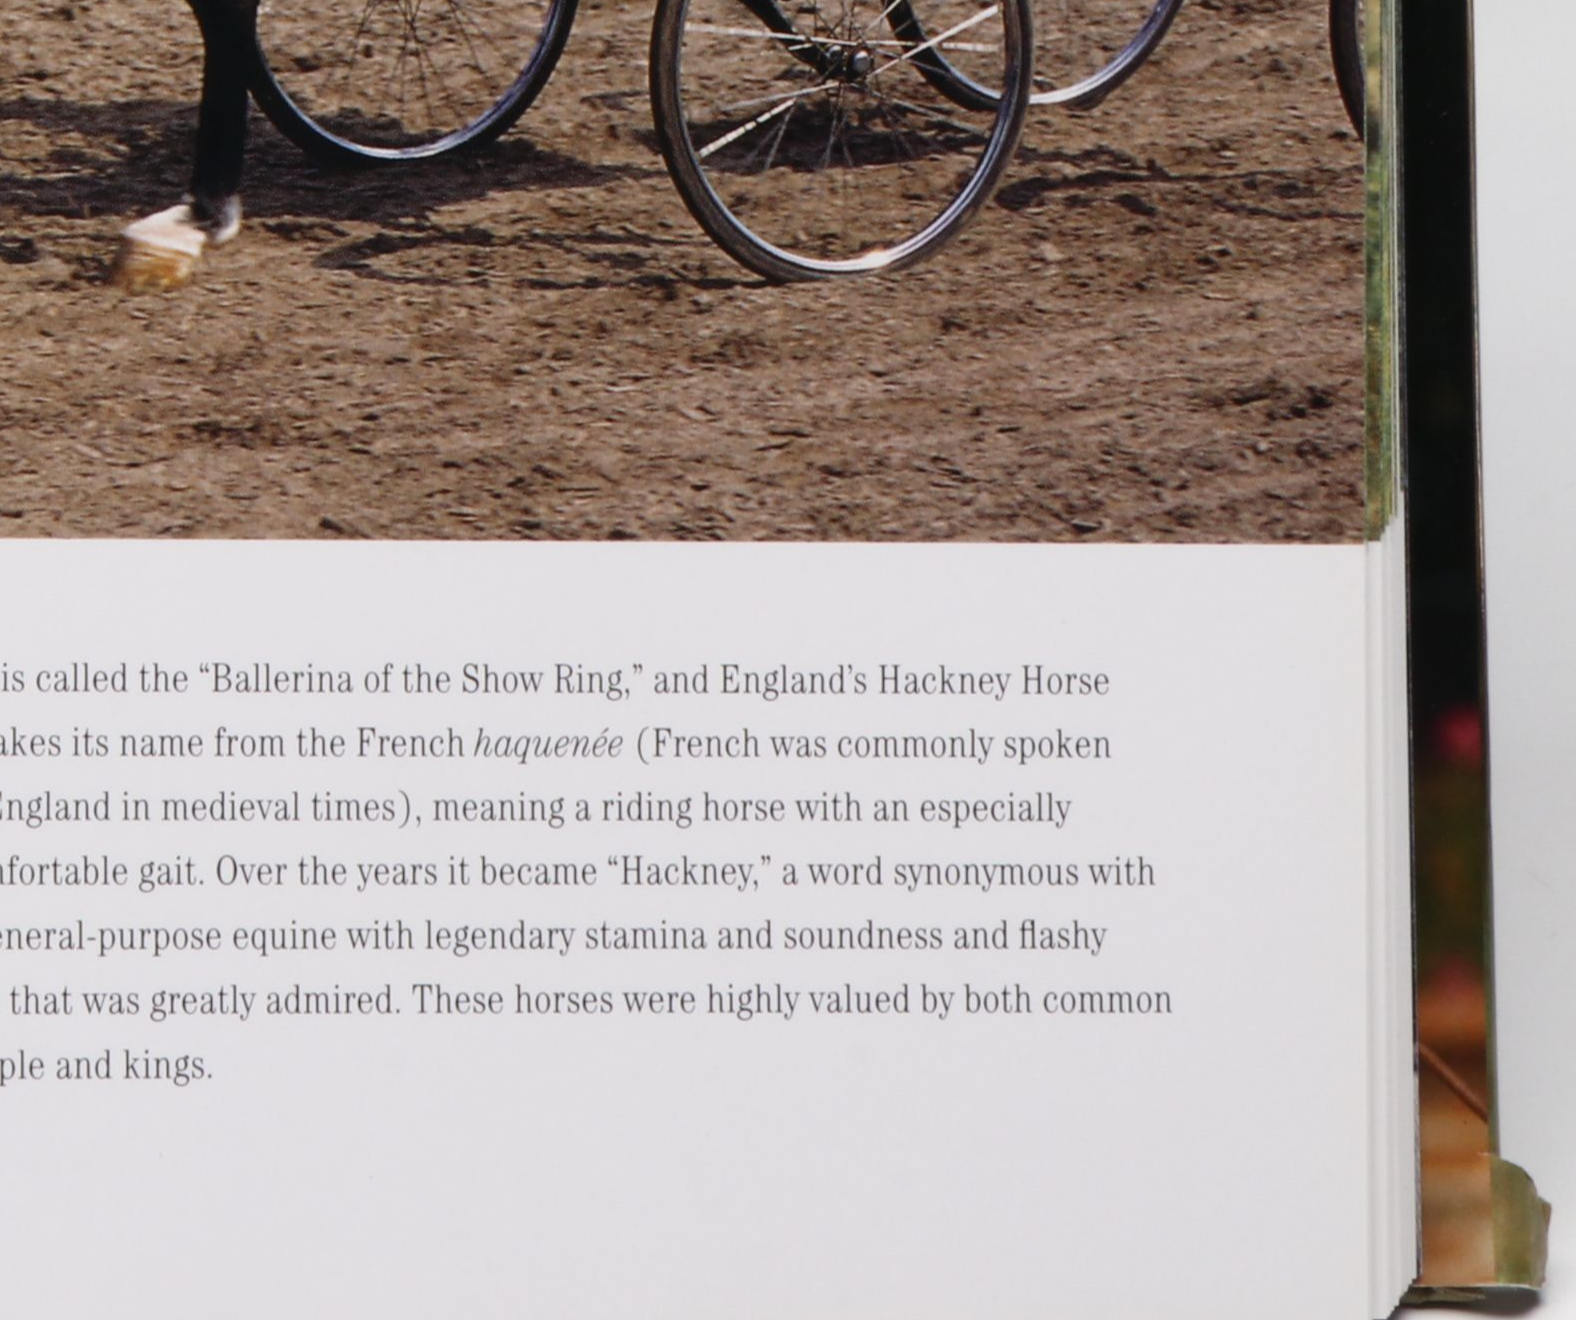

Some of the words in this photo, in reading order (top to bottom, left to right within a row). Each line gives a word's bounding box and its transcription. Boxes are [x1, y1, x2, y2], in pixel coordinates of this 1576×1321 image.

[2, 663, 24, 692] is
[36, 662, 127, 692] called
[140, 663, 188, 692] the
[200, 663, 353, 693] “Ballerina
[364, 663, 394, 693] of
[403, 664, 450, 693] the
[463, 663, 543, 693] Show
[555, 664, 642, 701] Ring,”
[654, 664, 708, 694] and
[721, 664, 867, 701] England’s
[879, 665, 1011, 701] Hackney
[1023, 665, 1109, 695] Horse
[73, 727, 108, 756] its
[121, 735, 203, 757] name
[215, 726, 285, 757] from
[297, 727, 345, 757] the
[358, 727, 464, 757] French
[474, 728, 623, 764] haquenée
[638, 727, 759, 764] (French
[770, 736, 826, 758] was
[838, 728, 994, 764] commonly
[1004, 729, 1111, 765] spoken
[123, 791, 149, 820] in
[162, 791, 299, 821] medieval
[312, 791, 421, 828] times),
[434, 792, 564, 829] meaning
[576, 800, 591, 821] a
[603, 792, 692, 829] riding
[704, 792, 785, 821] horse
[795, 792, 861, 821] with
[874, 800, 908, 821] an
[920, 792, 1071, 828] especially
[139, 856, 203, 893] gait.
[217, 855, 287, 885] Over
[298, 855, 346, 885] the
[357, 864, 437, 892] years
[449, 856, 469, 885] it
[481, 856, 596, 885] became
[608, 855, 771, 891] “Hackney,”
[783, 864, 798, 885] a
[808, 856, 882, 885] word
[894, 864, 1078, 892] synonymous
[1088, 856, 1154, 886] with
[233, 920, 336, 957] equine
[347, 920, 413, 949] with
[426, 920, 575, 957] legendary
[586, 920, 707, 949] stamina
[718, 920, 772, 949] and
[784, 920, 942, 949] soundness
[954, 920, 1008, 949] and
[1019, 919, 1106, 956] flashy
[10, 985, 72, 1015] that
[82, 993, 139, 1014] was
[150, 984, 256, 1022] greatly
[267, 984, 400, 1014] admired.
[412, 984, 503, 1014] These
[516, 984, 613, 1014] horses
[623, 992, 695, 1013] were
[708, 984, 800, 1021] highly
[809, 984, 909, 1013] valued
[921, 984, 955, 1020] by
[965, 984, 1031, 1013] both
[1043, 992, 1172, 1013] common
[57, 1049, 111, 1079] and
[124, 1049, 212, 1087] kings.
